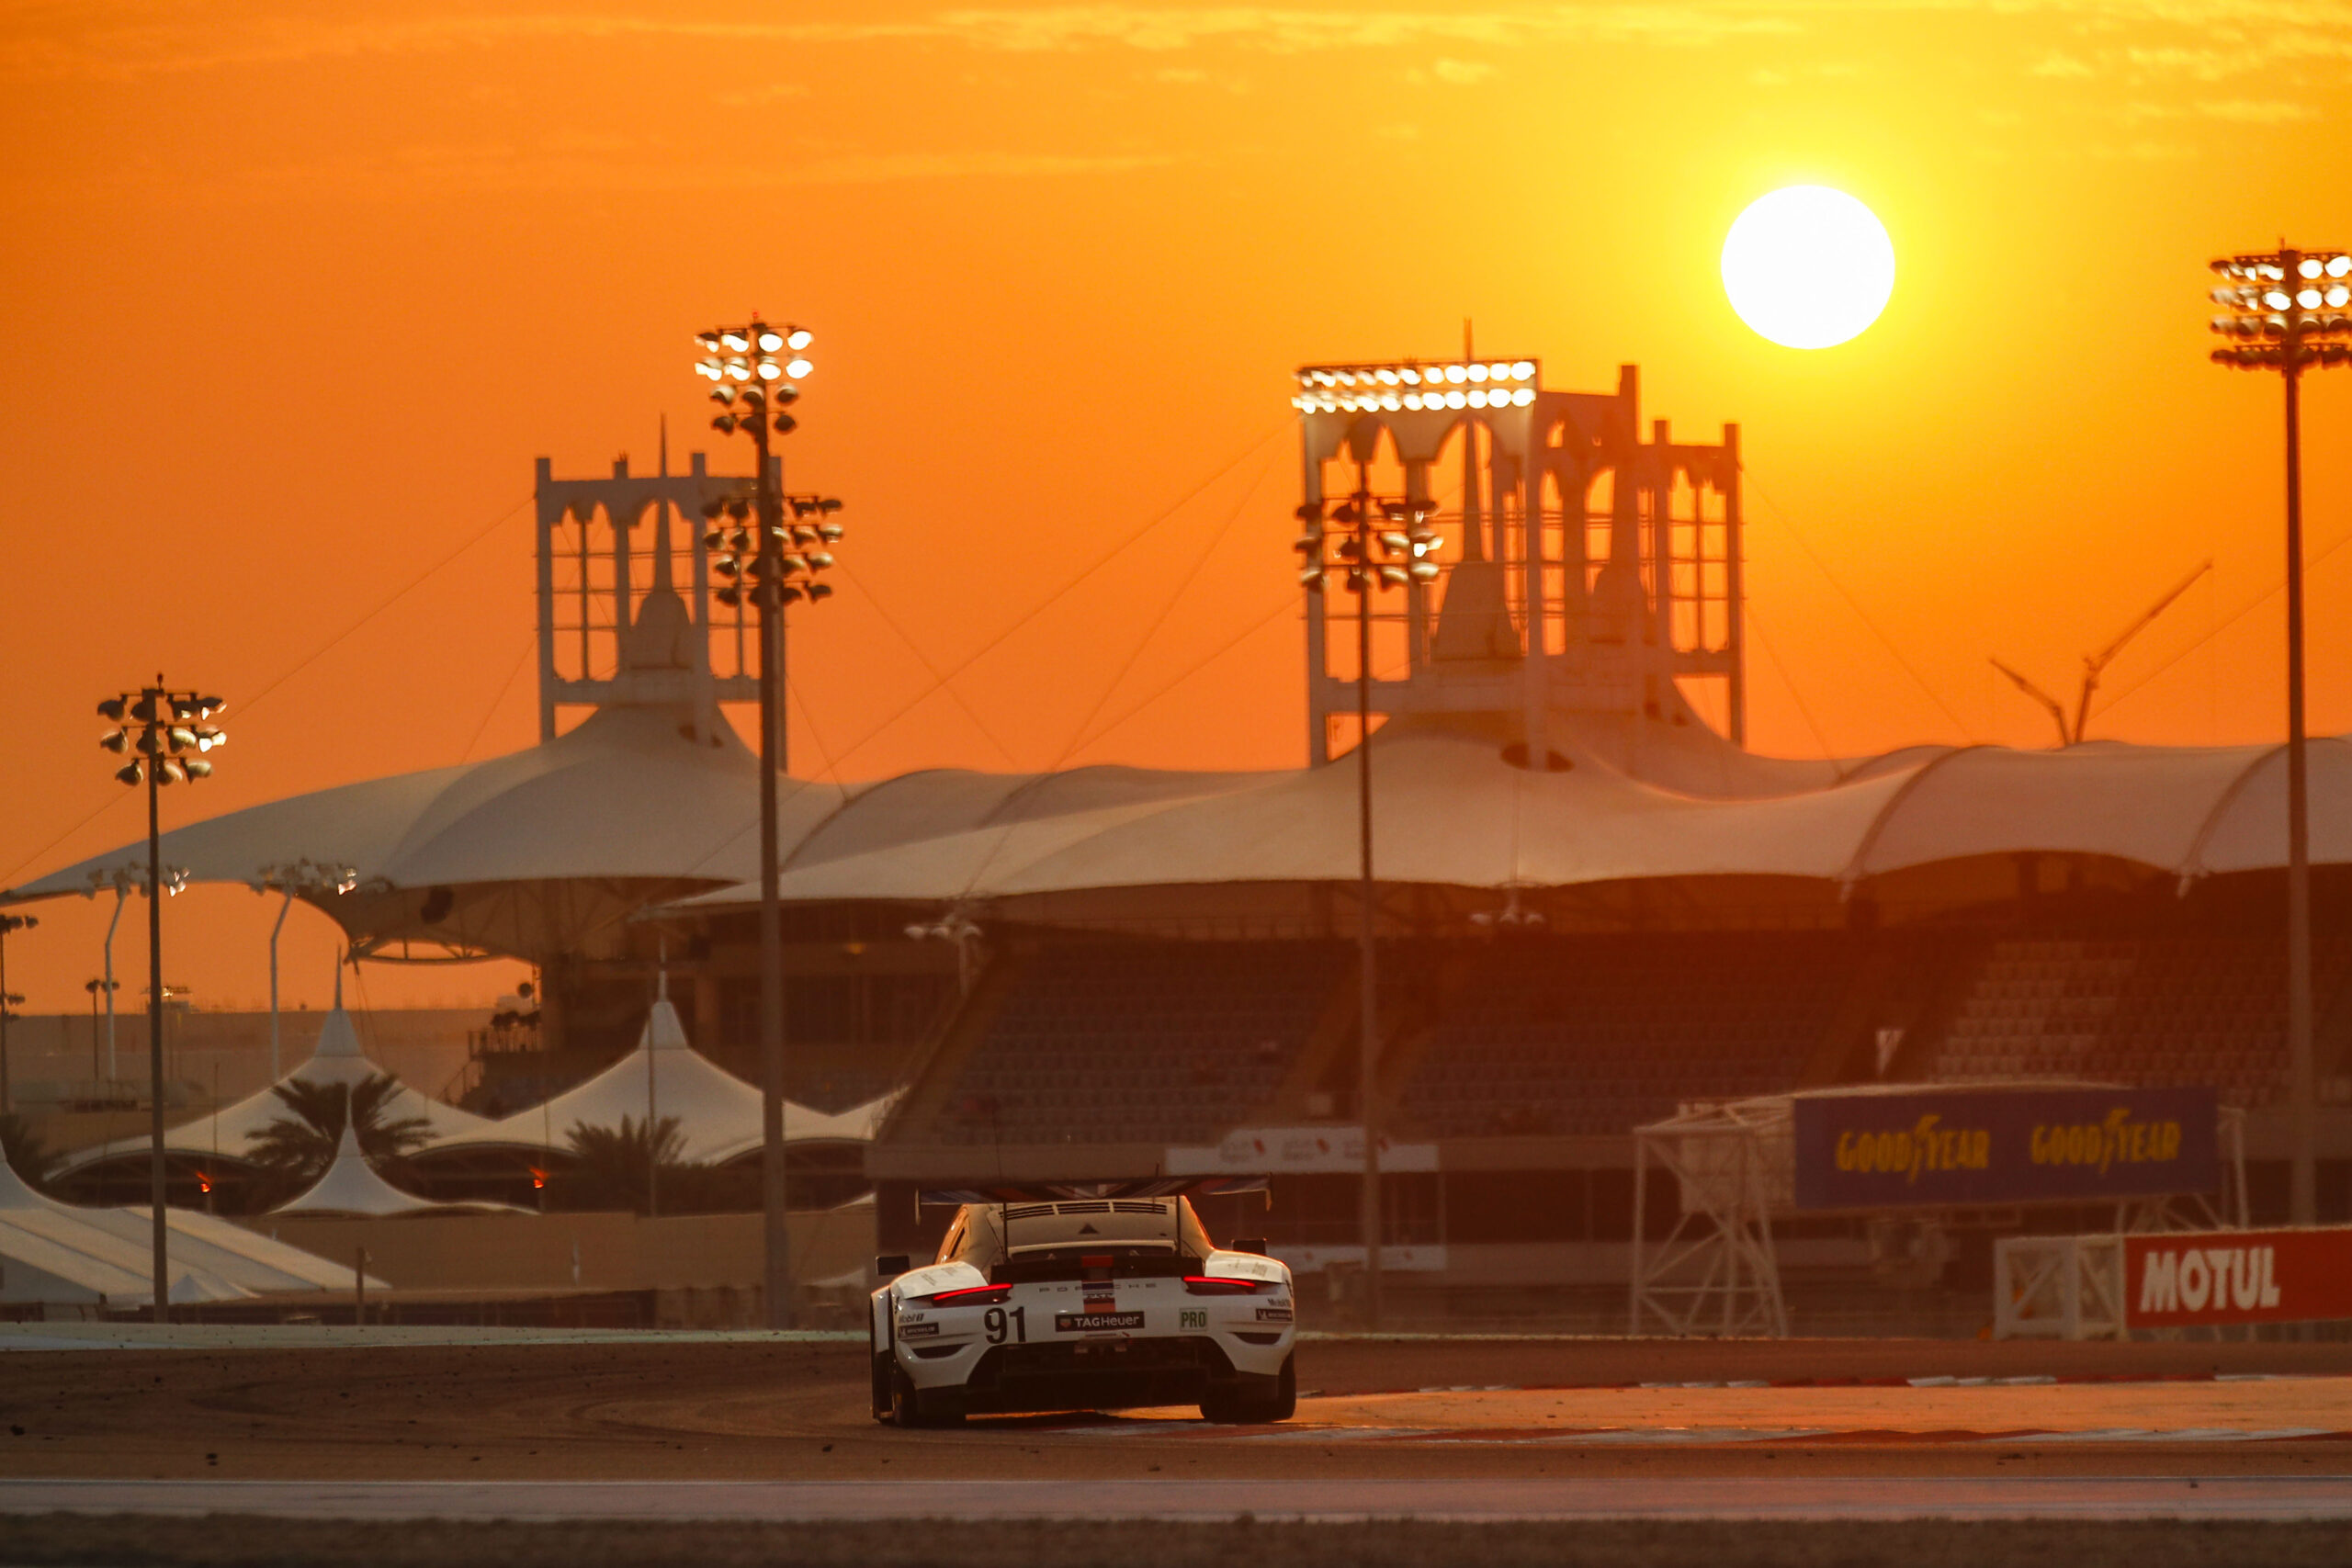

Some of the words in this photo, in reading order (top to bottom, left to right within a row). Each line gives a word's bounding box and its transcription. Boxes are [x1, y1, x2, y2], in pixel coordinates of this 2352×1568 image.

[1836, 1119, 1989, 1179] GOODYEAR
[2030, 1111, 2181, 1171] GOODYEAR
[1038, 1283, 1157, 1292] PORCHE
[2140, 1246, 2280, 1313] MOTUL
[984, 1306, 1026, 1345] 91
[1181, 1312, 1206, 1328] PRO
